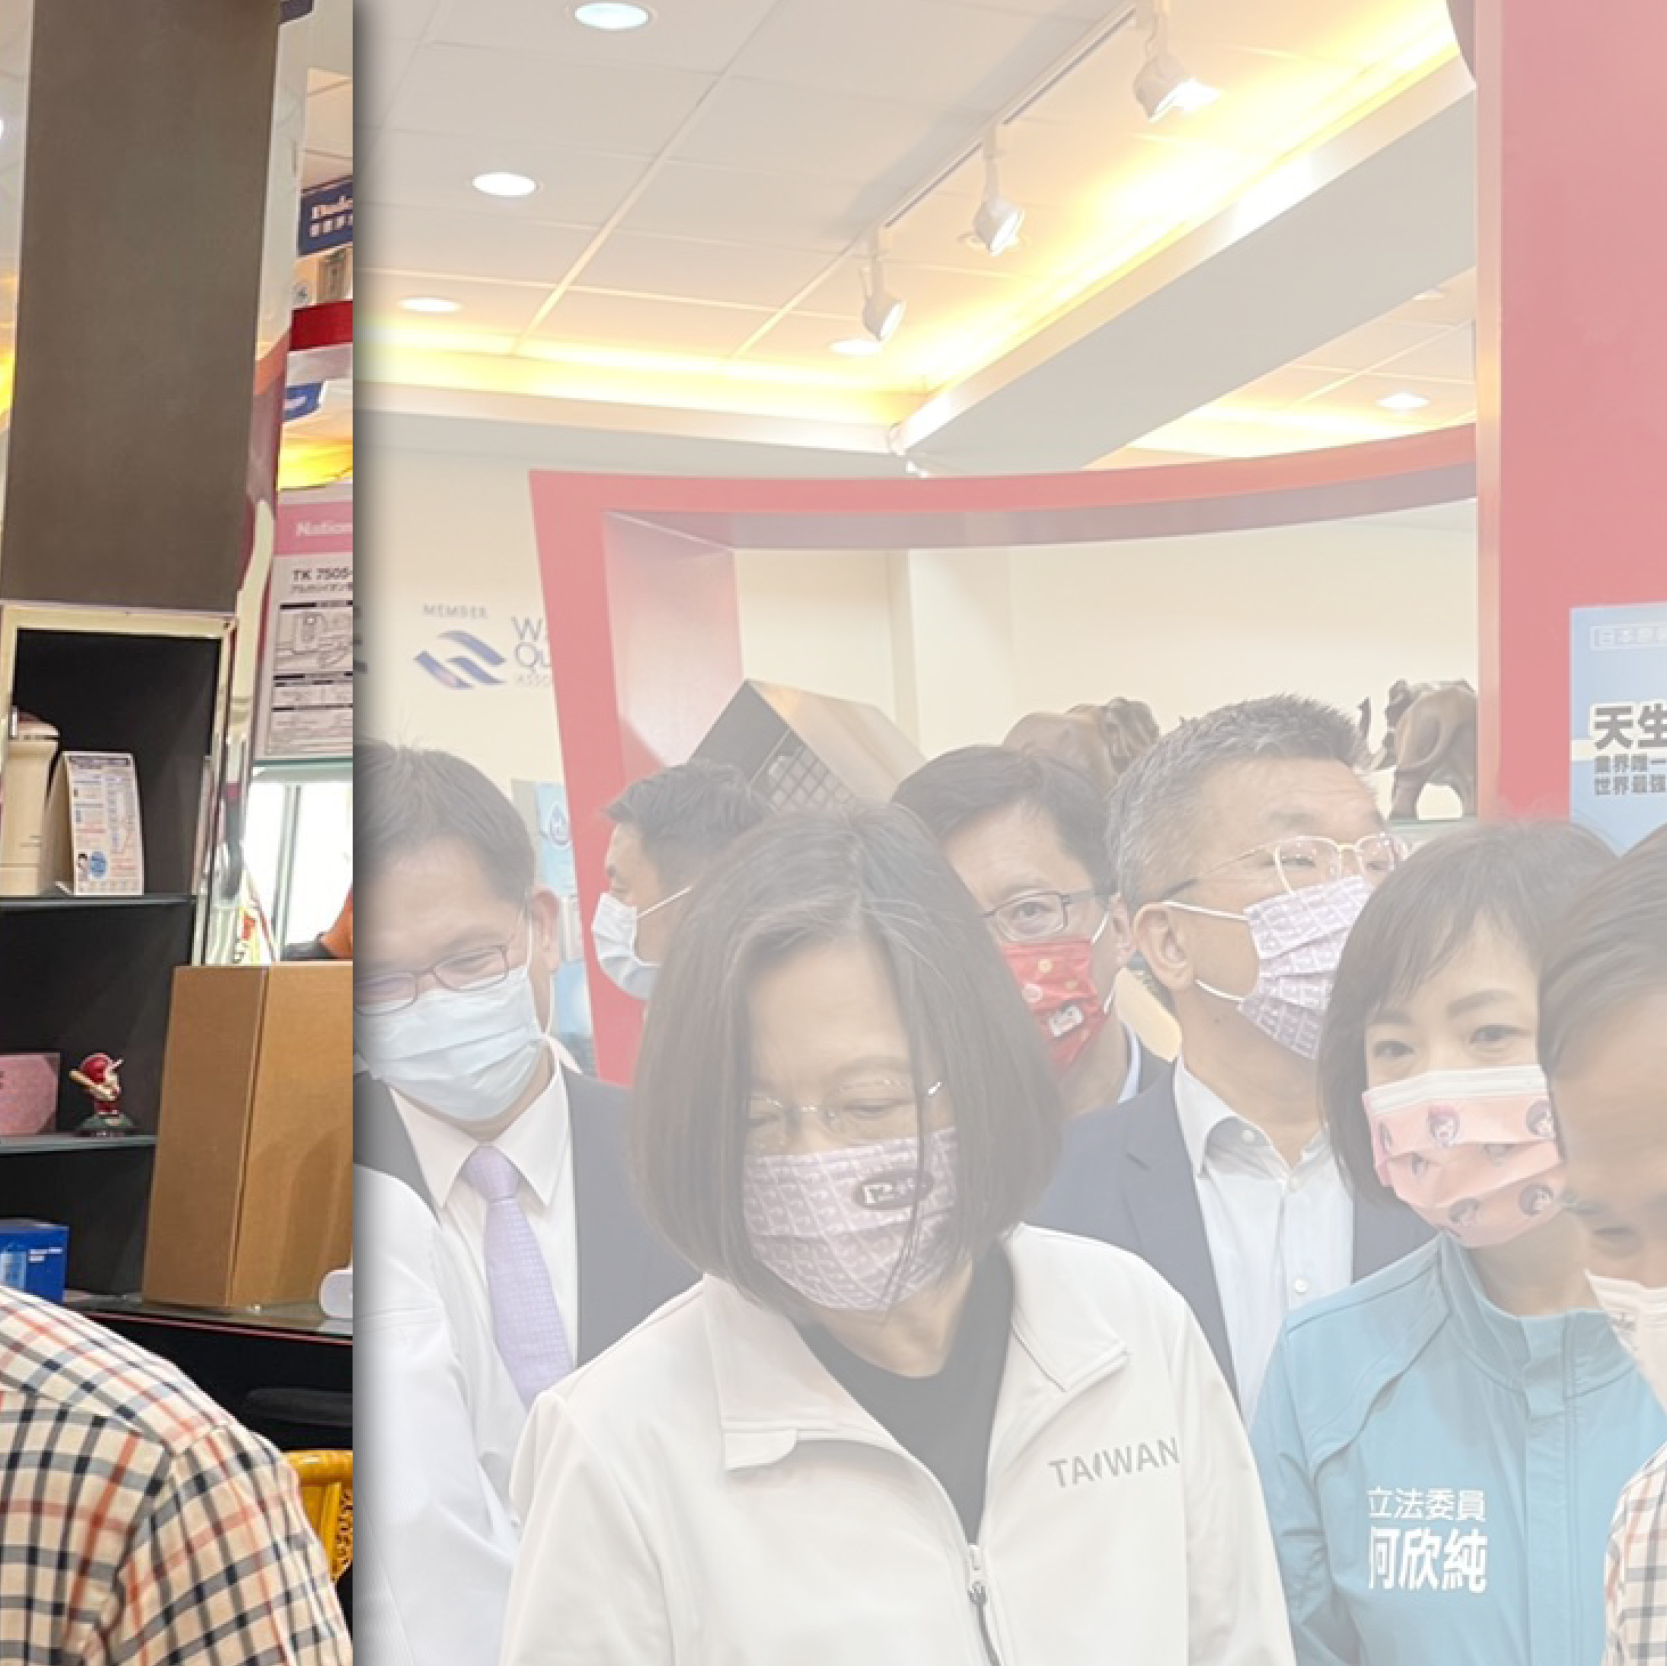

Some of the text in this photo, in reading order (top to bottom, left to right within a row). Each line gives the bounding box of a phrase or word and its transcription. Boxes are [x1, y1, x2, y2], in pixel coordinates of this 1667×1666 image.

[1049, 1437, 1181, 1489] TAIWAN
[1368, 1486, 1487, 1523] 立法委員
[1368, 1526, 1488, 1594] 何欣純
